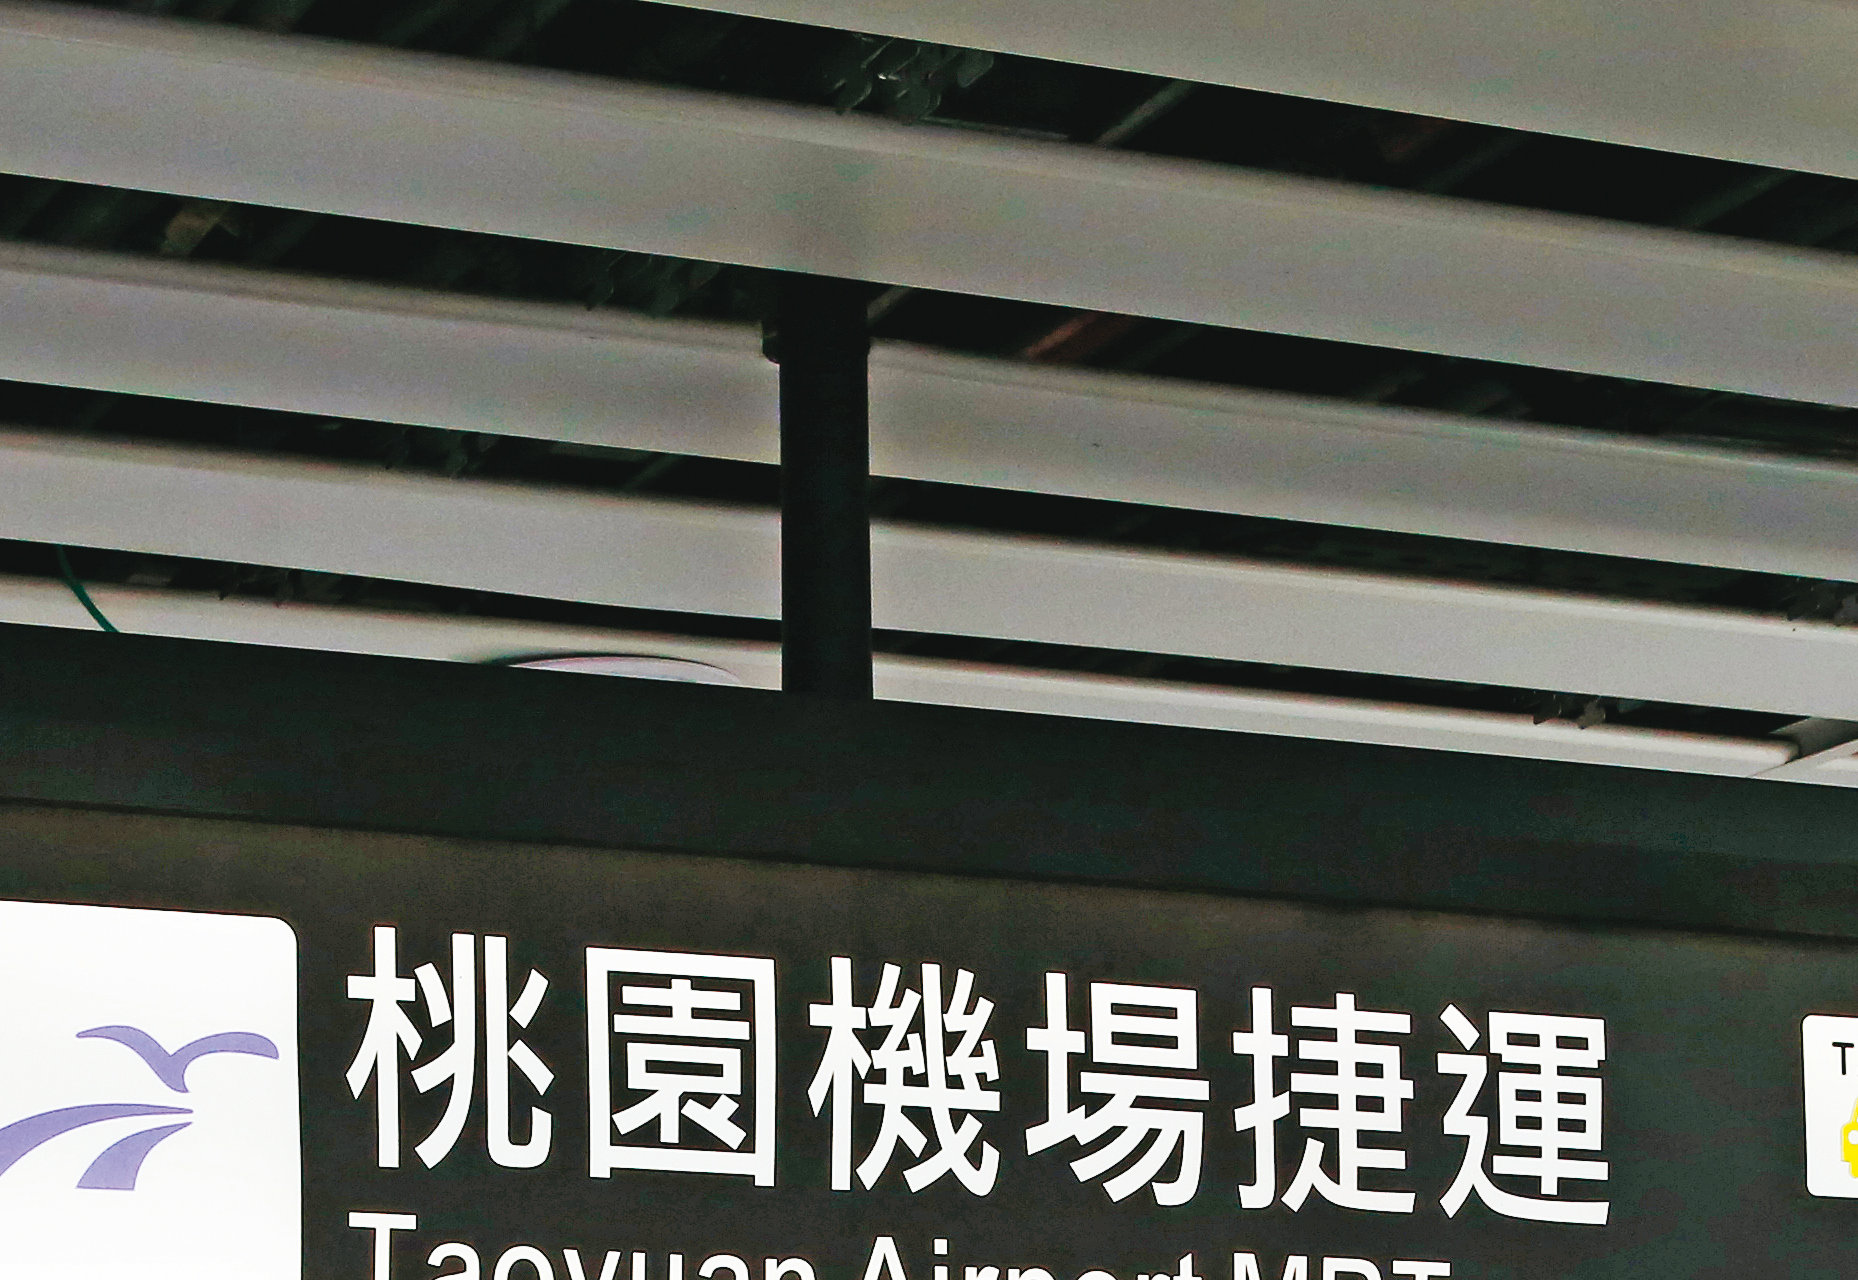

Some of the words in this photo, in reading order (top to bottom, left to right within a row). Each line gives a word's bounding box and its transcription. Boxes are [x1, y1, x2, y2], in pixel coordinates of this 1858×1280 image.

[345, 926, 1610, 1226] 桃園機場捷運
